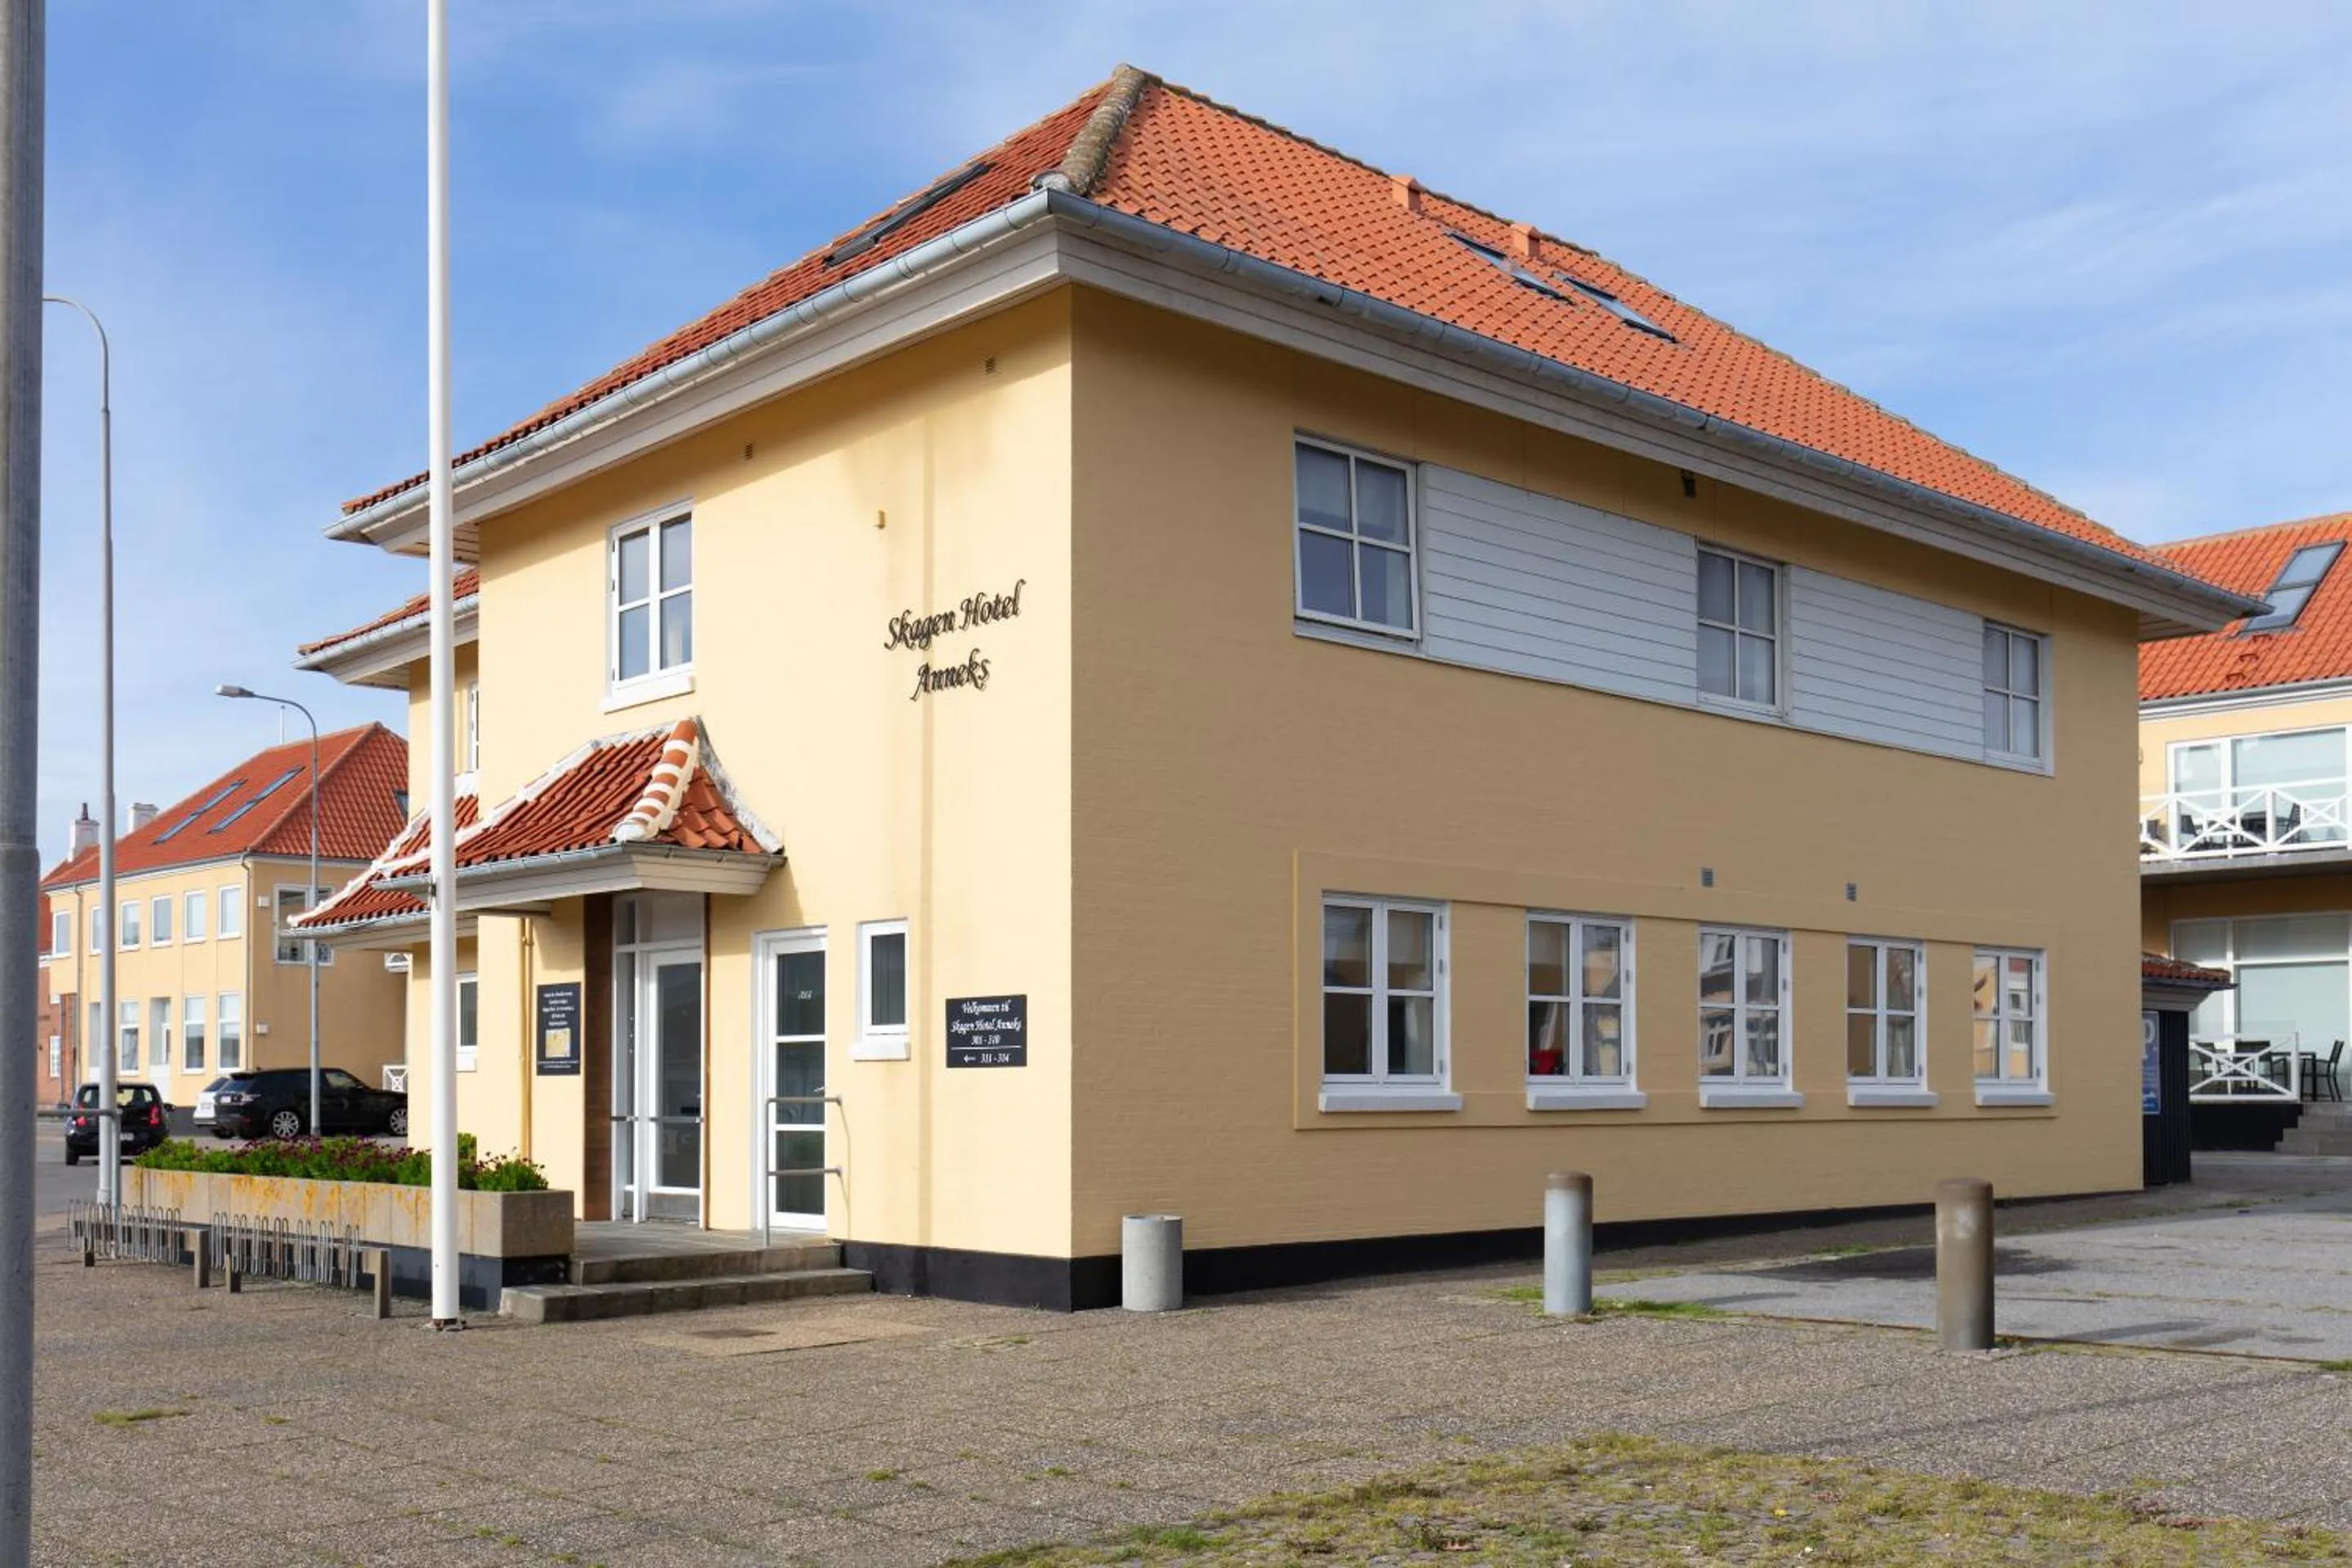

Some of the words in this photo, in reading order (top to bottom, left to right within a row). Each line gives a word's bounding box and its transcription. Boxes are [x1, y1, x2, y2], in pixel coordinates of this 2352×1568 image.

[884, 609, 956, 650] Skagen
[959, 578, 1026, 630] Hotel
[910, 648, 991, 701] Anneks
